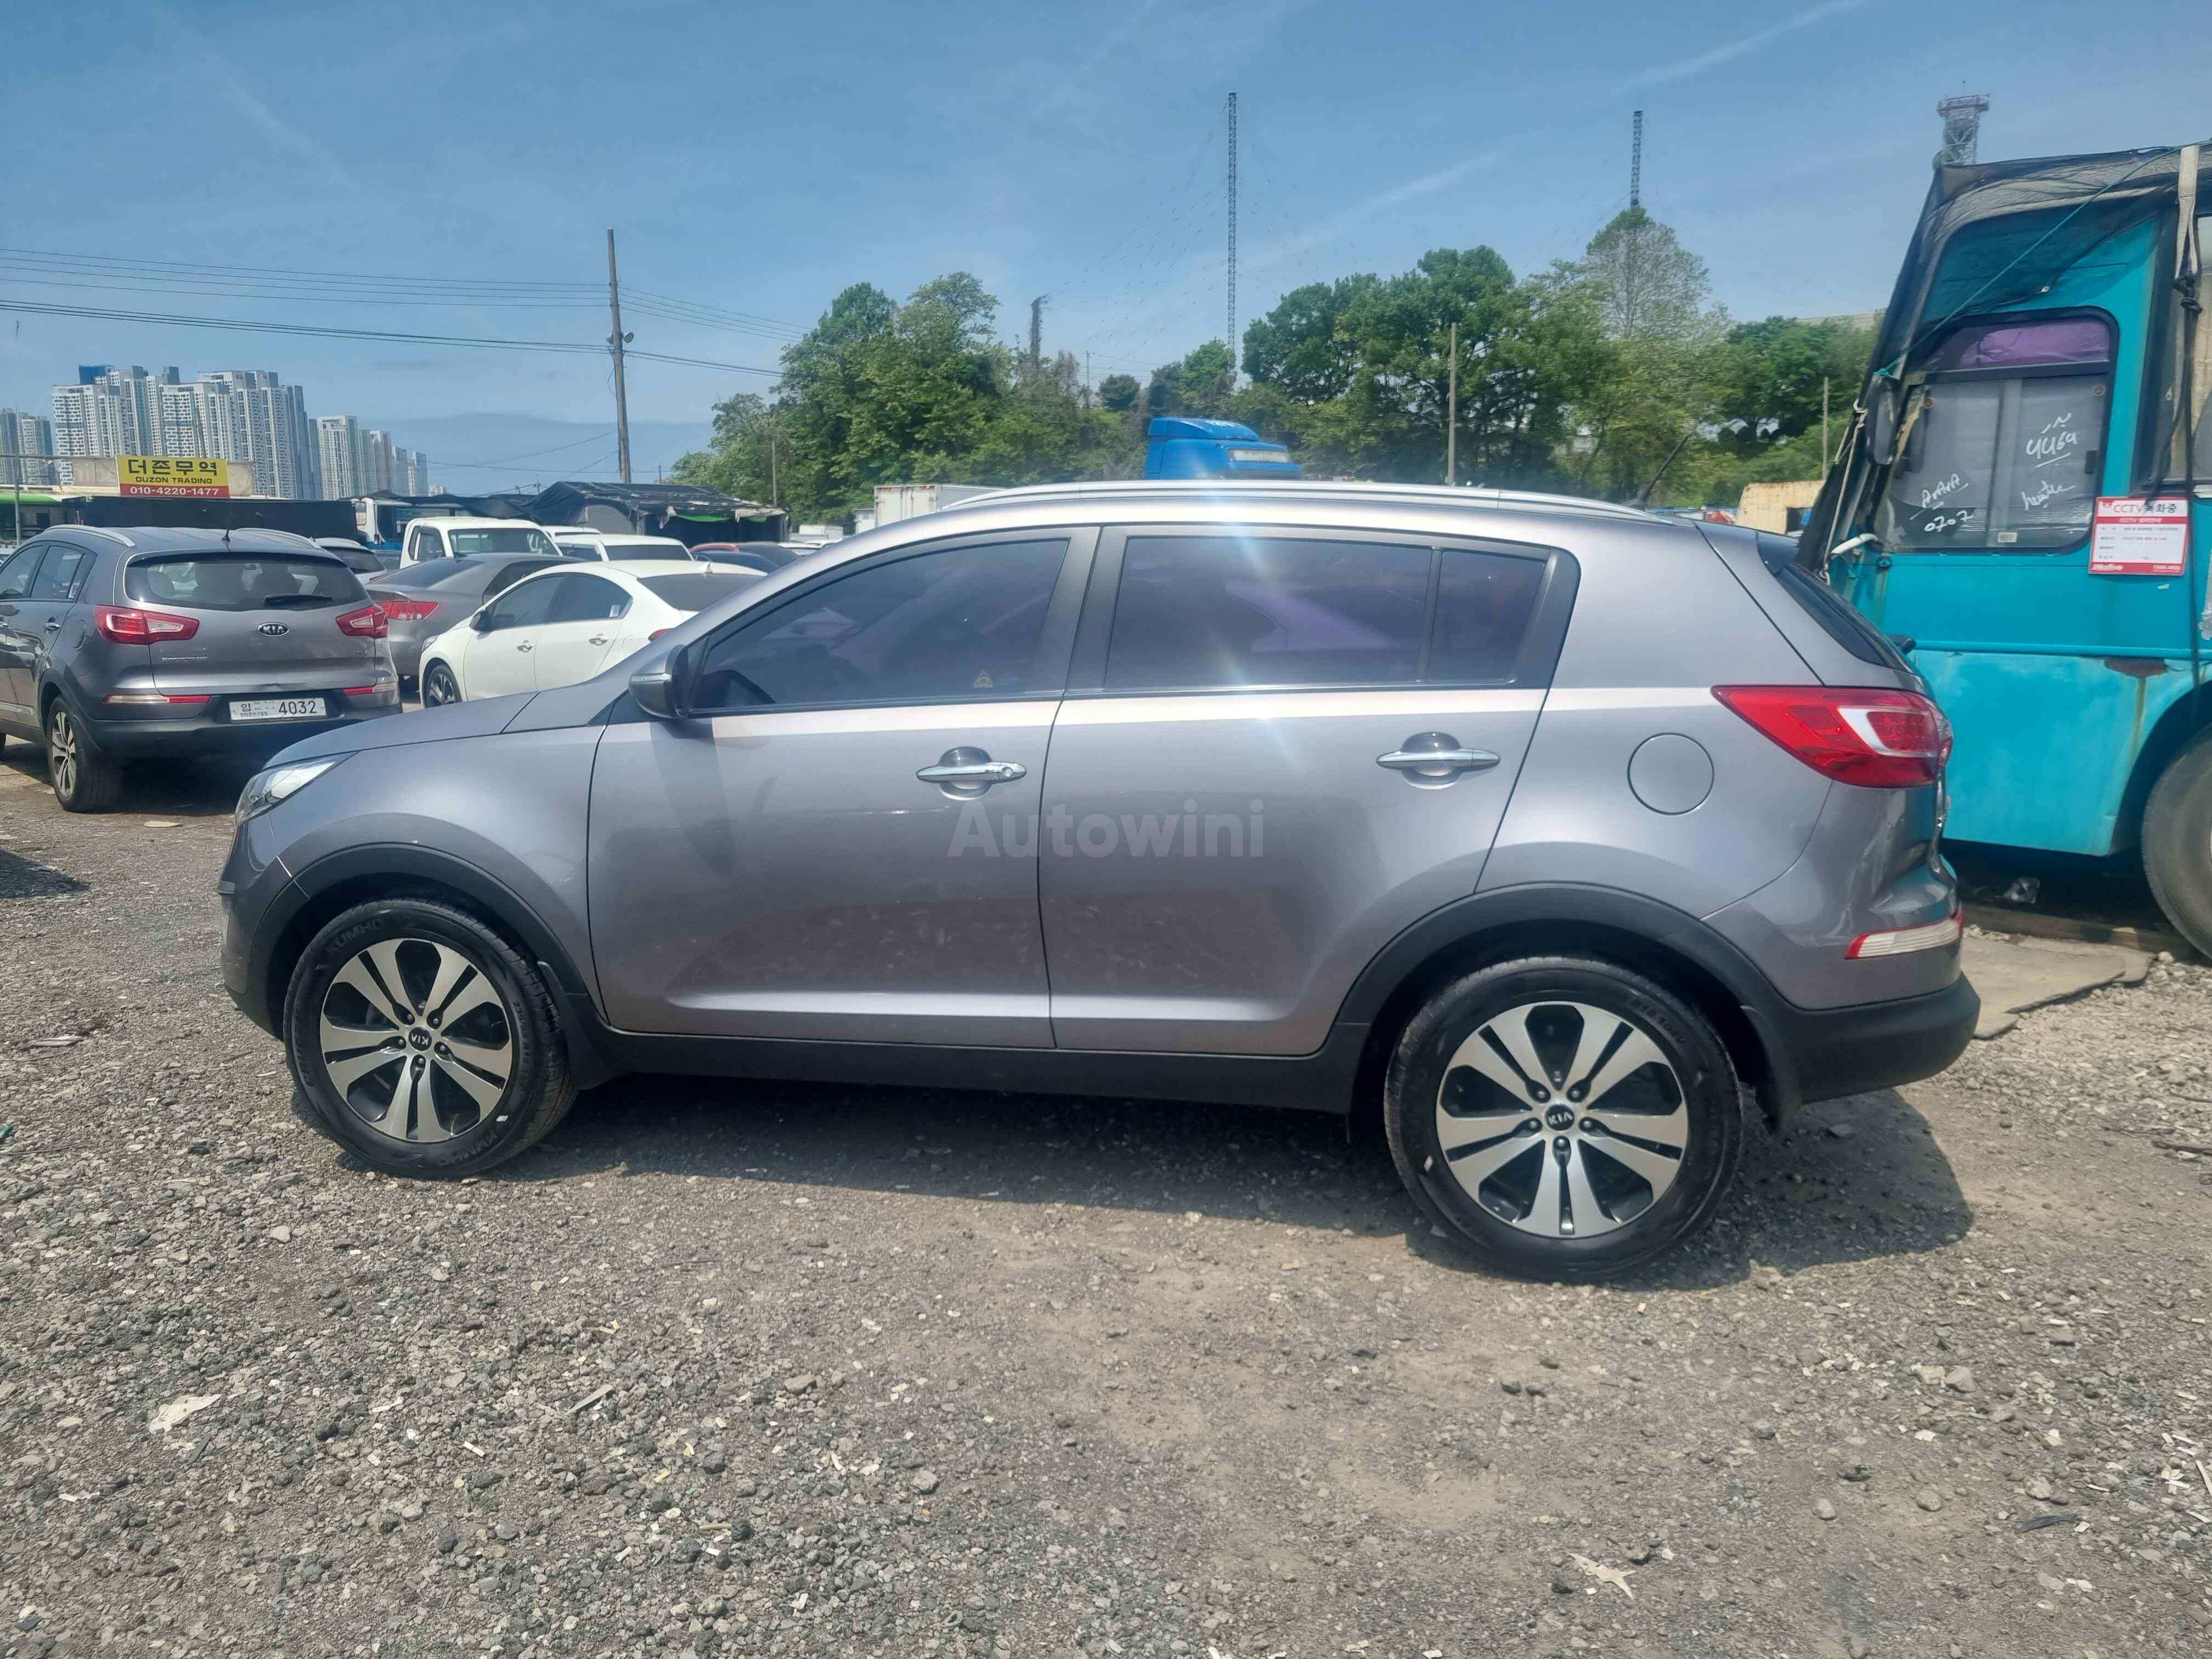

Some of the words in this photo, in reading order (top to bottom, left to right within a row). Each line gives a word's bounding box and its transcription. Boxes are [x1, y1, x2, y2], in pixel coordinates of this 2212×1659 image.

[128, 459, 217, 476] 더존무역
[129, 486, 219, 495] 010-4220-1477
[2113, 504, 2142, 513] CCTV
[263, 625, 285, 634] KIA
[240, 703, 251, 712] 임
[278, 701, 317, 715] 4032
[411, 1032, 430, 1046] KIA
[1547, 1111, 1573, 1125] KIA
